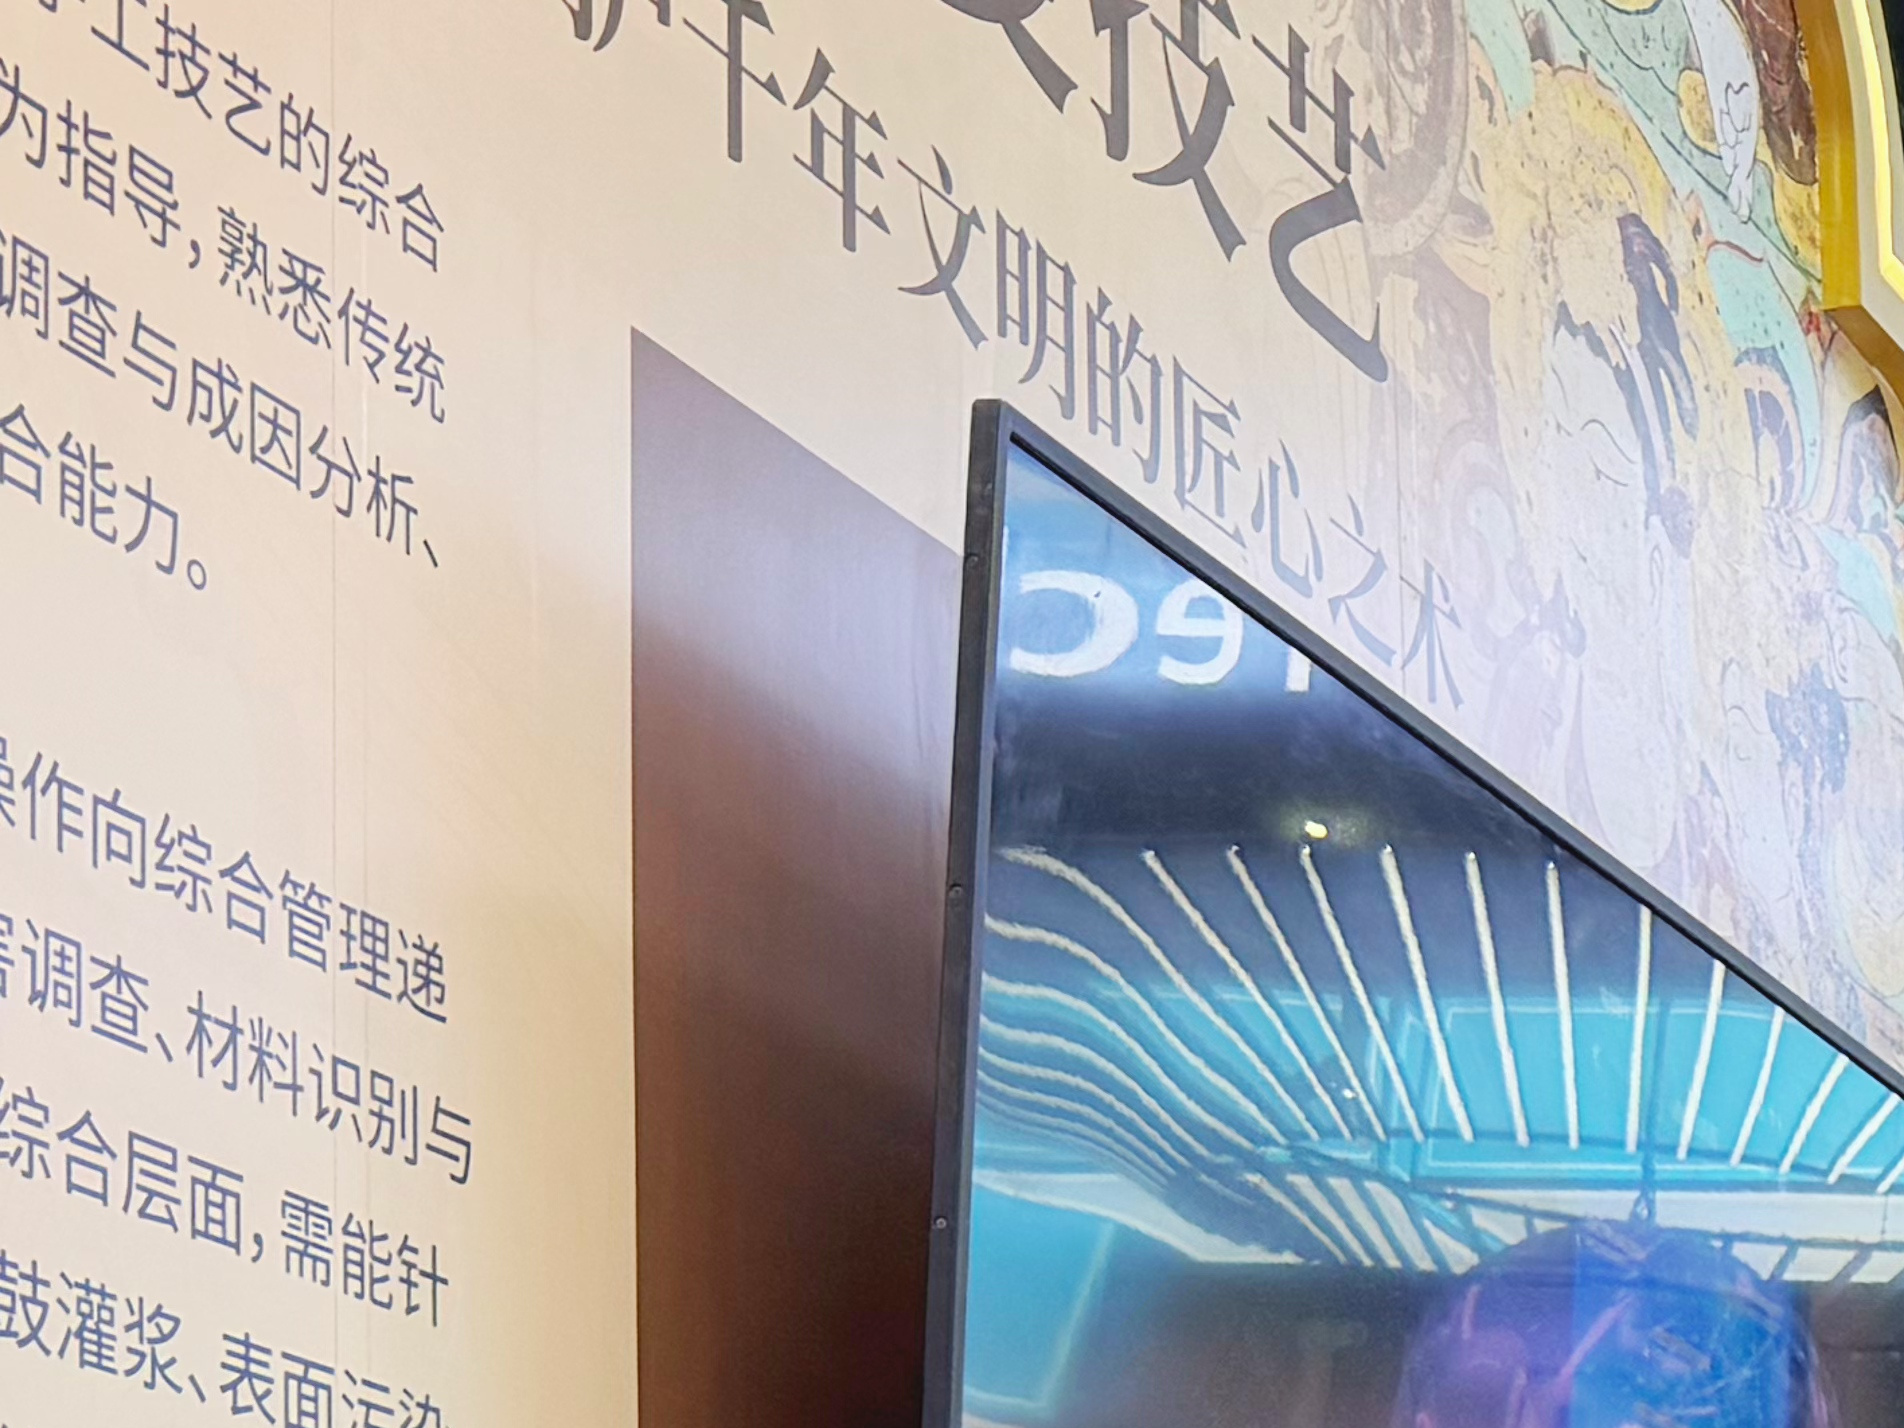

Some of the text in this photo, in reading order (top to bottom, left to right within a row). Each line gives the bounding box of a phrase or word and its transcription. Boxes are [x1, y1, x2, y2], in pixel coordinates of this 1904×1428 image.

[38, 0, 445, 272] 工技艺的综合
[562, 0, 1466, 709] 千年文明的匠心之术
[0, 403, 207, 590] 合能力。
[0, 737, 448, 1024] 作向综合管理递
